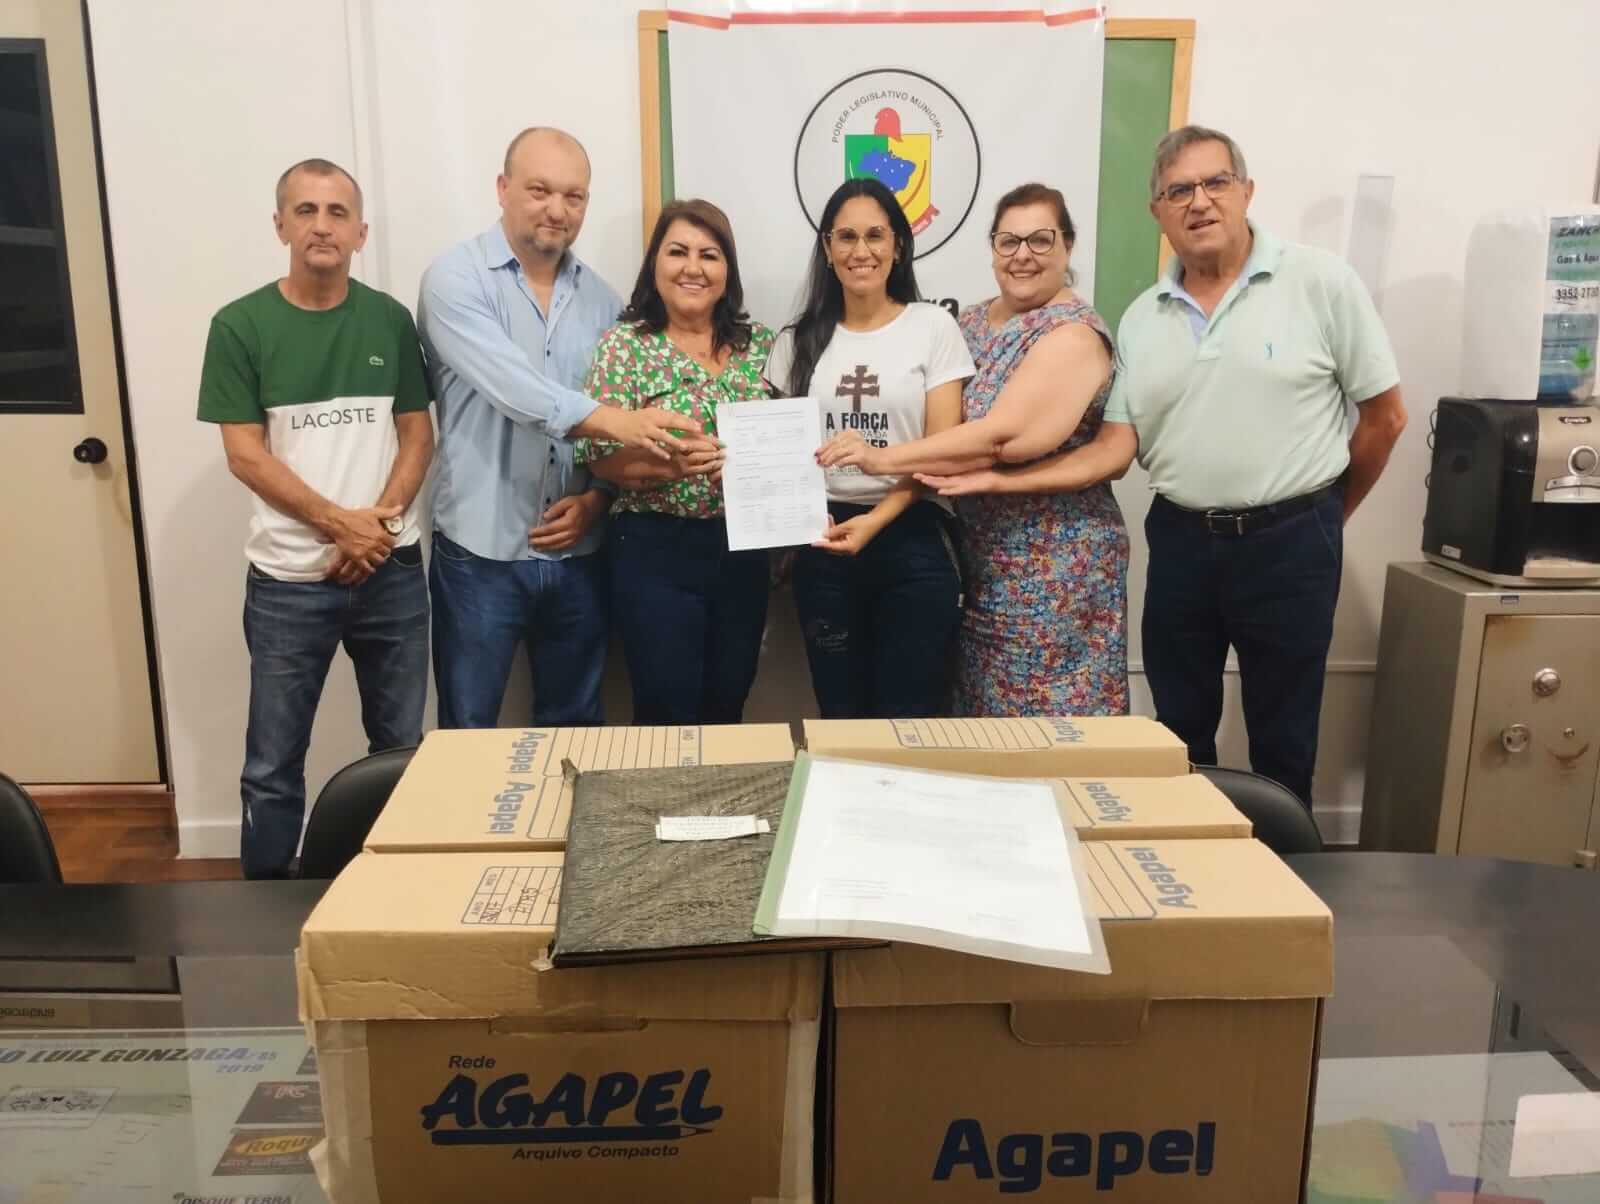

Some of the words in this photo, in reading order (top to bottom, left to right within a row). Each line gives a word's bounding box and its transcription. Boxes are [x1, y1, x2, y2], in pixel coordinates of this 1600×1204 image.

[831, 110, 850, 144] PODER
[849, 89, 909, 112] LEGISLATIVO
[910, 95, 945, 141] MUNICIPAL
[291, 407, 377, 431] LACOSTE
[826, 412, 835, 430] A
[841, 412, 889, 433] FORÇA
[506, 731, 549, 774] Agapel
[486, 780, 537, 834] Agapel
[1080, 781, 1132, 823] Agapel
[1124, 846, 1199, 911] Agapel
[26, 1049, 93, 1064] LUIZ
[101, 1047, 249, 1063] GONZAGA
[448, 1055, 496, 1069] Rede
[420, 1068, 724, 1131] AGAPEL
[511, 1147, 583, 1161] Arquivo
[587, 1144, 680, 1161] Compacto
[932, 1118, 1217, 1193] Agapel
